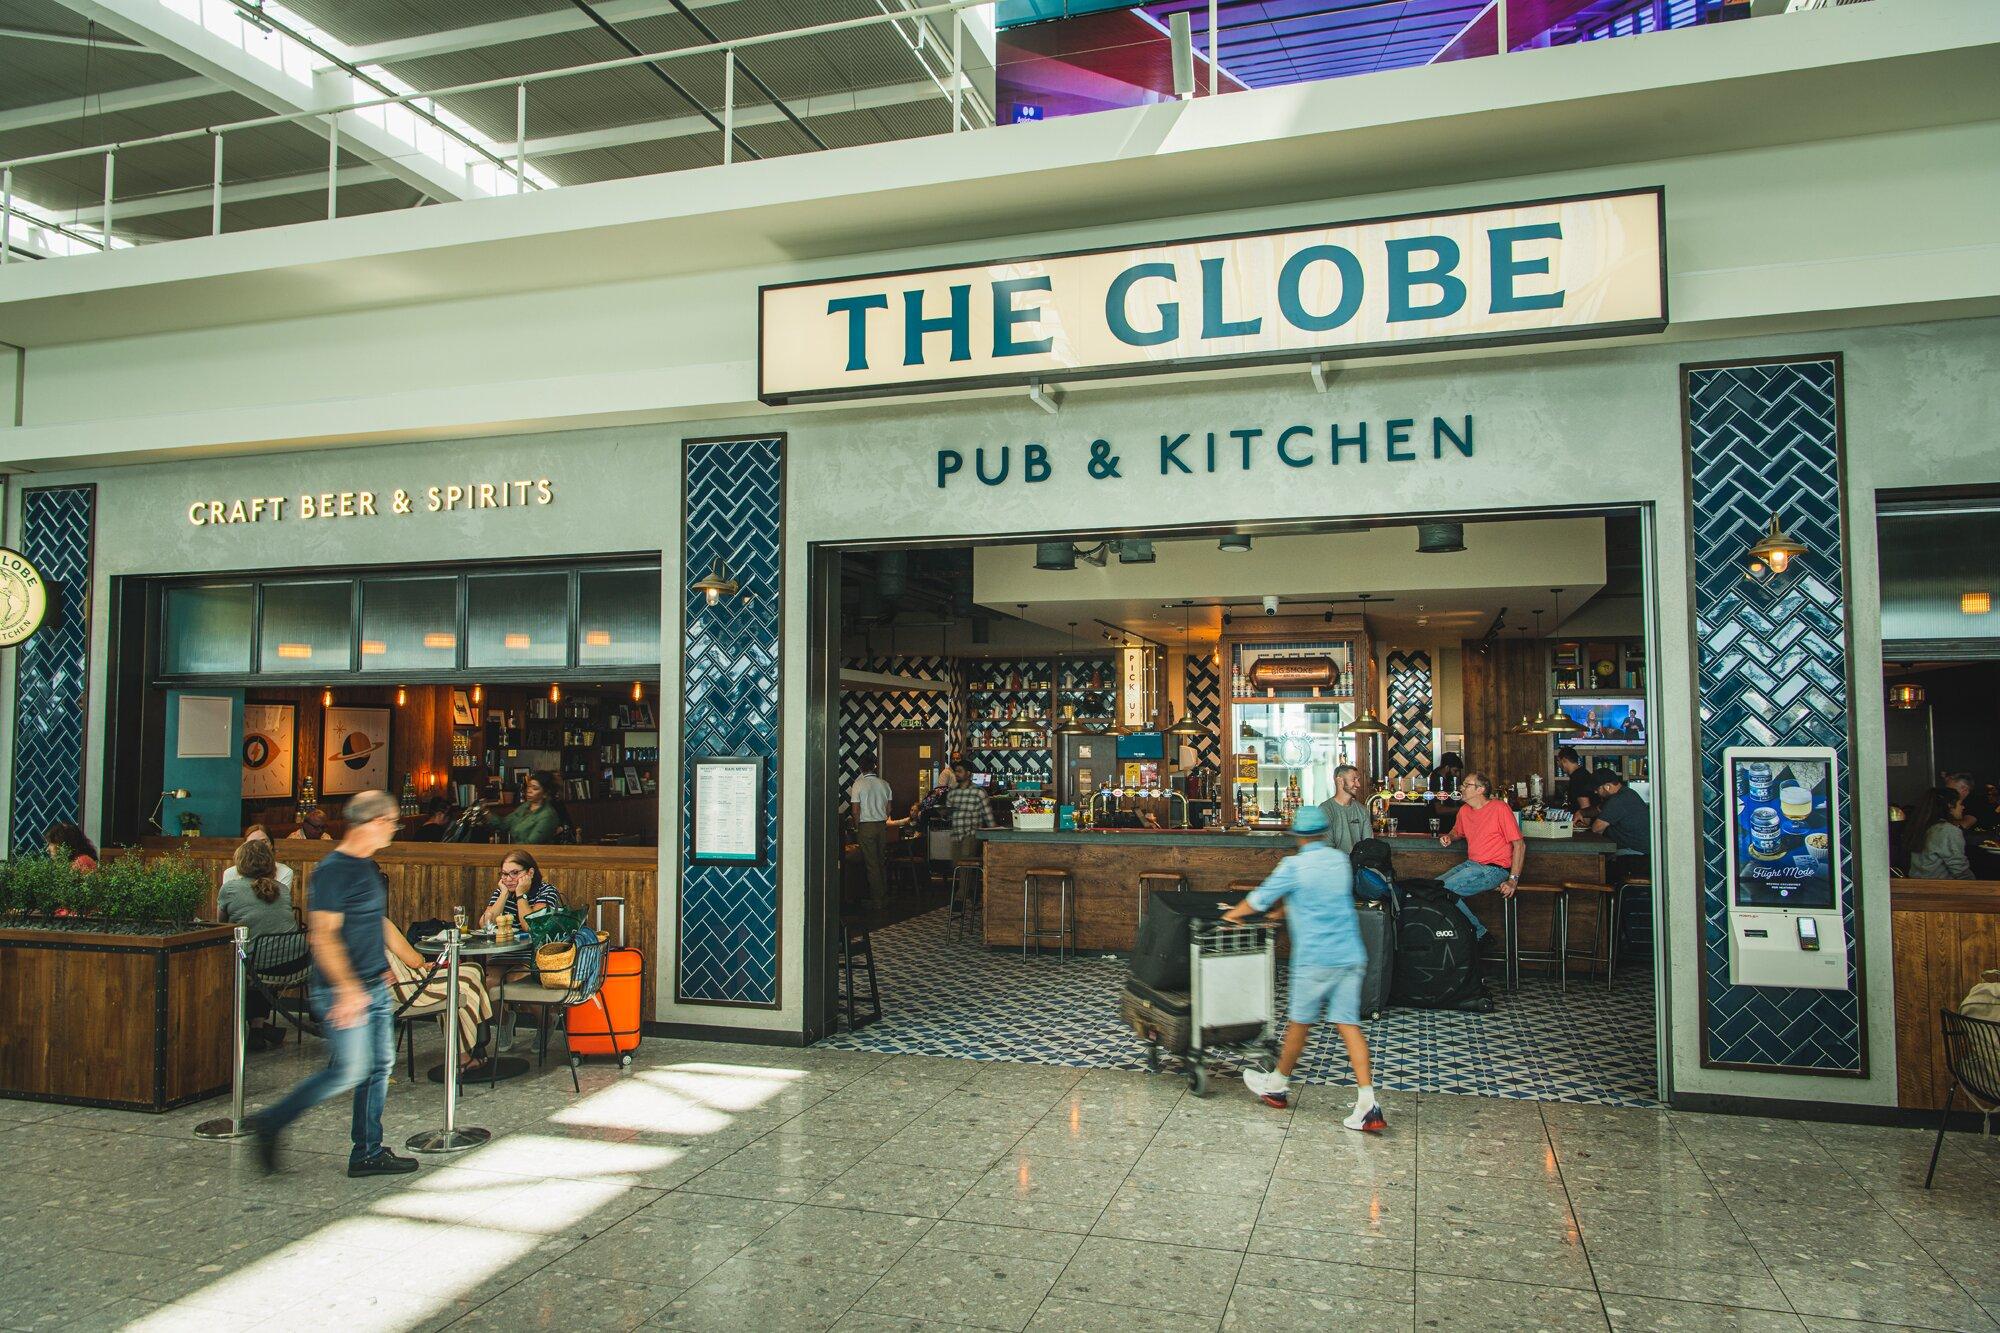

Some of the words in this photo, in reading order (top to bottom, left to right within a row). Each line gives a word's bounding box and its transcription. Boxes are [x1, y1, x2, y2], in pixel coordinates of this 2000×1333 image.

[826, 275, 1053, 372] THE
[1104, 222, 1566, 347] GLOBE
[937, 443, 1053, 489] PUB
[1087, 439, 1122, 479] &
[1159, 414, 1474, 476] KITCHEN
[188, 496, 287, 526] CRAFT
[300, 490, 378, 519] BEER
[392, 488, 412, 514] &
[427, 478, 553, 512] SPIRITS
[1, 556, 38, 587] LOBE
[0, 619, 31, 640] TCHEN
[1286, 666, 1313, 675] SMOKE
[1129, 703, 1136, 719] UP
[1753, 866, 1782, 879] Flight
[1783, 866, 1815, 879] Mode
